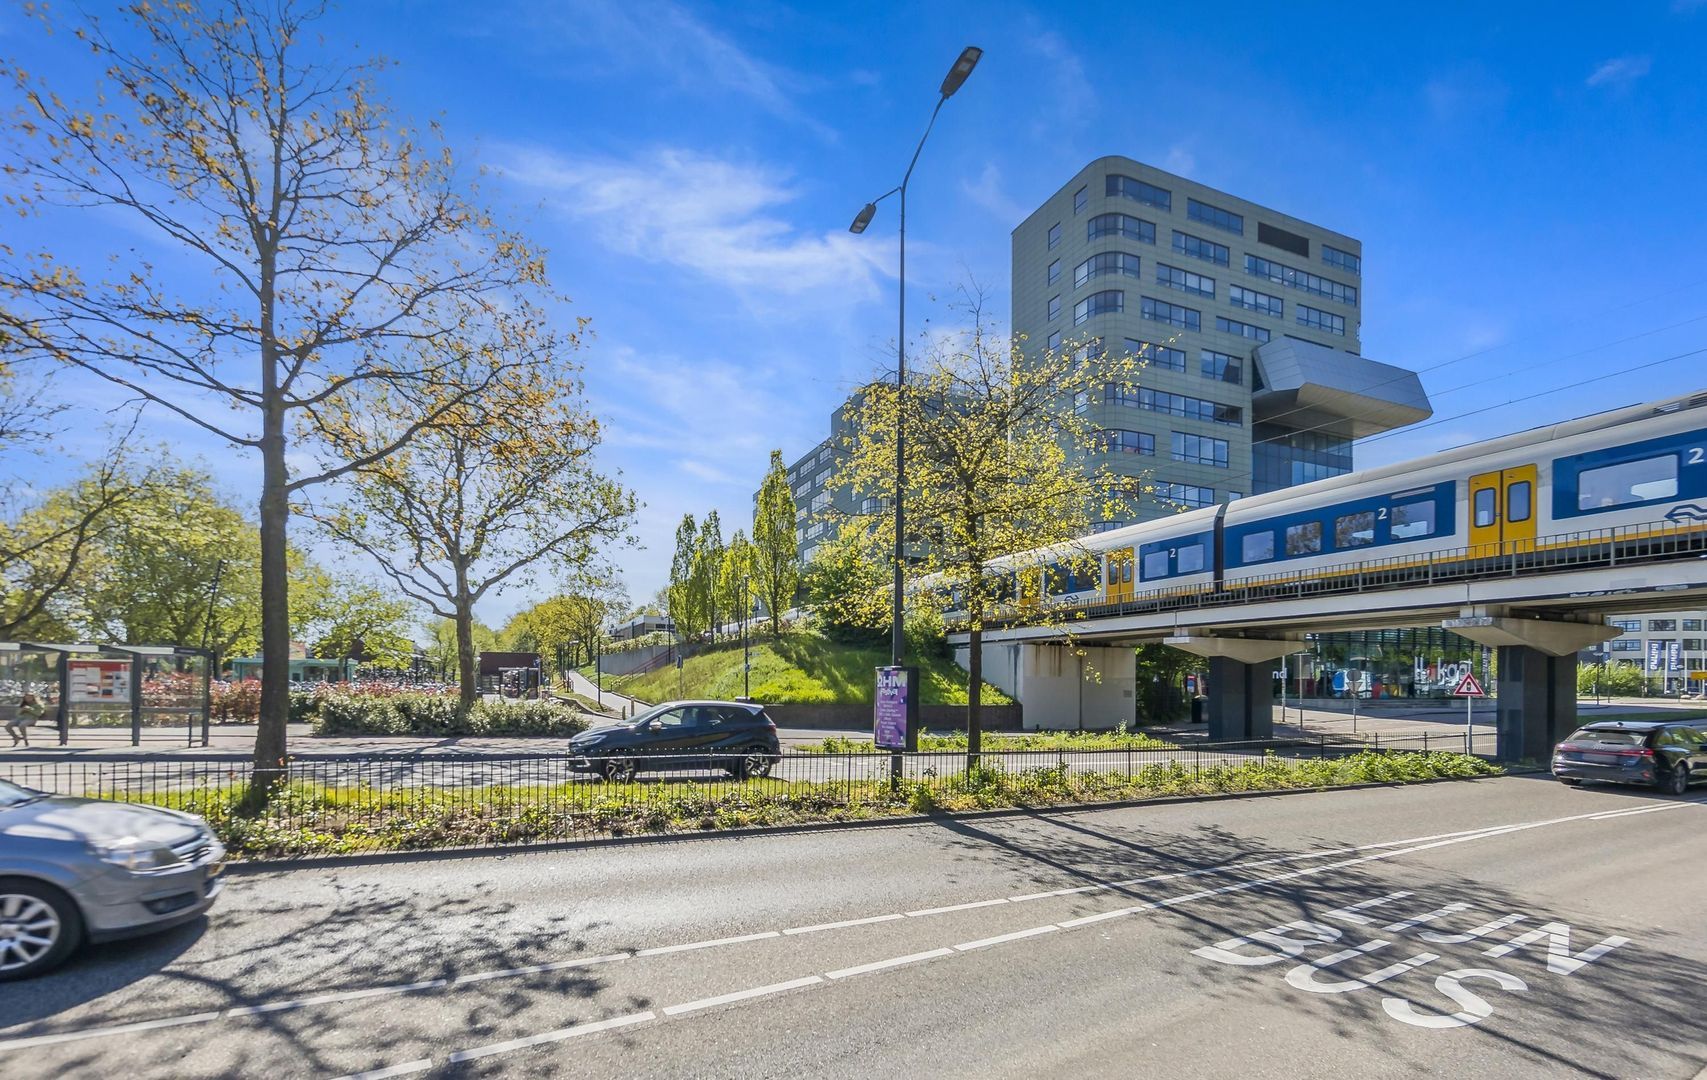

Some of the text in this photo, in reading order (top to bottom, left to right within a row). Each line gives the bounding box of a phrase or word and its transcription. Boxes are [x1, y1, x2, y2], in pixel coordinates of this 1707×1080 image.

[1688, 447, 1704, 464] 2
[1378, 507, 1387, 520] 2
[1169, 548, 1176, 558] 2
[1321, 891, 1631, 976] LIJN
[1190, 919, 1529, 1029] BUS
